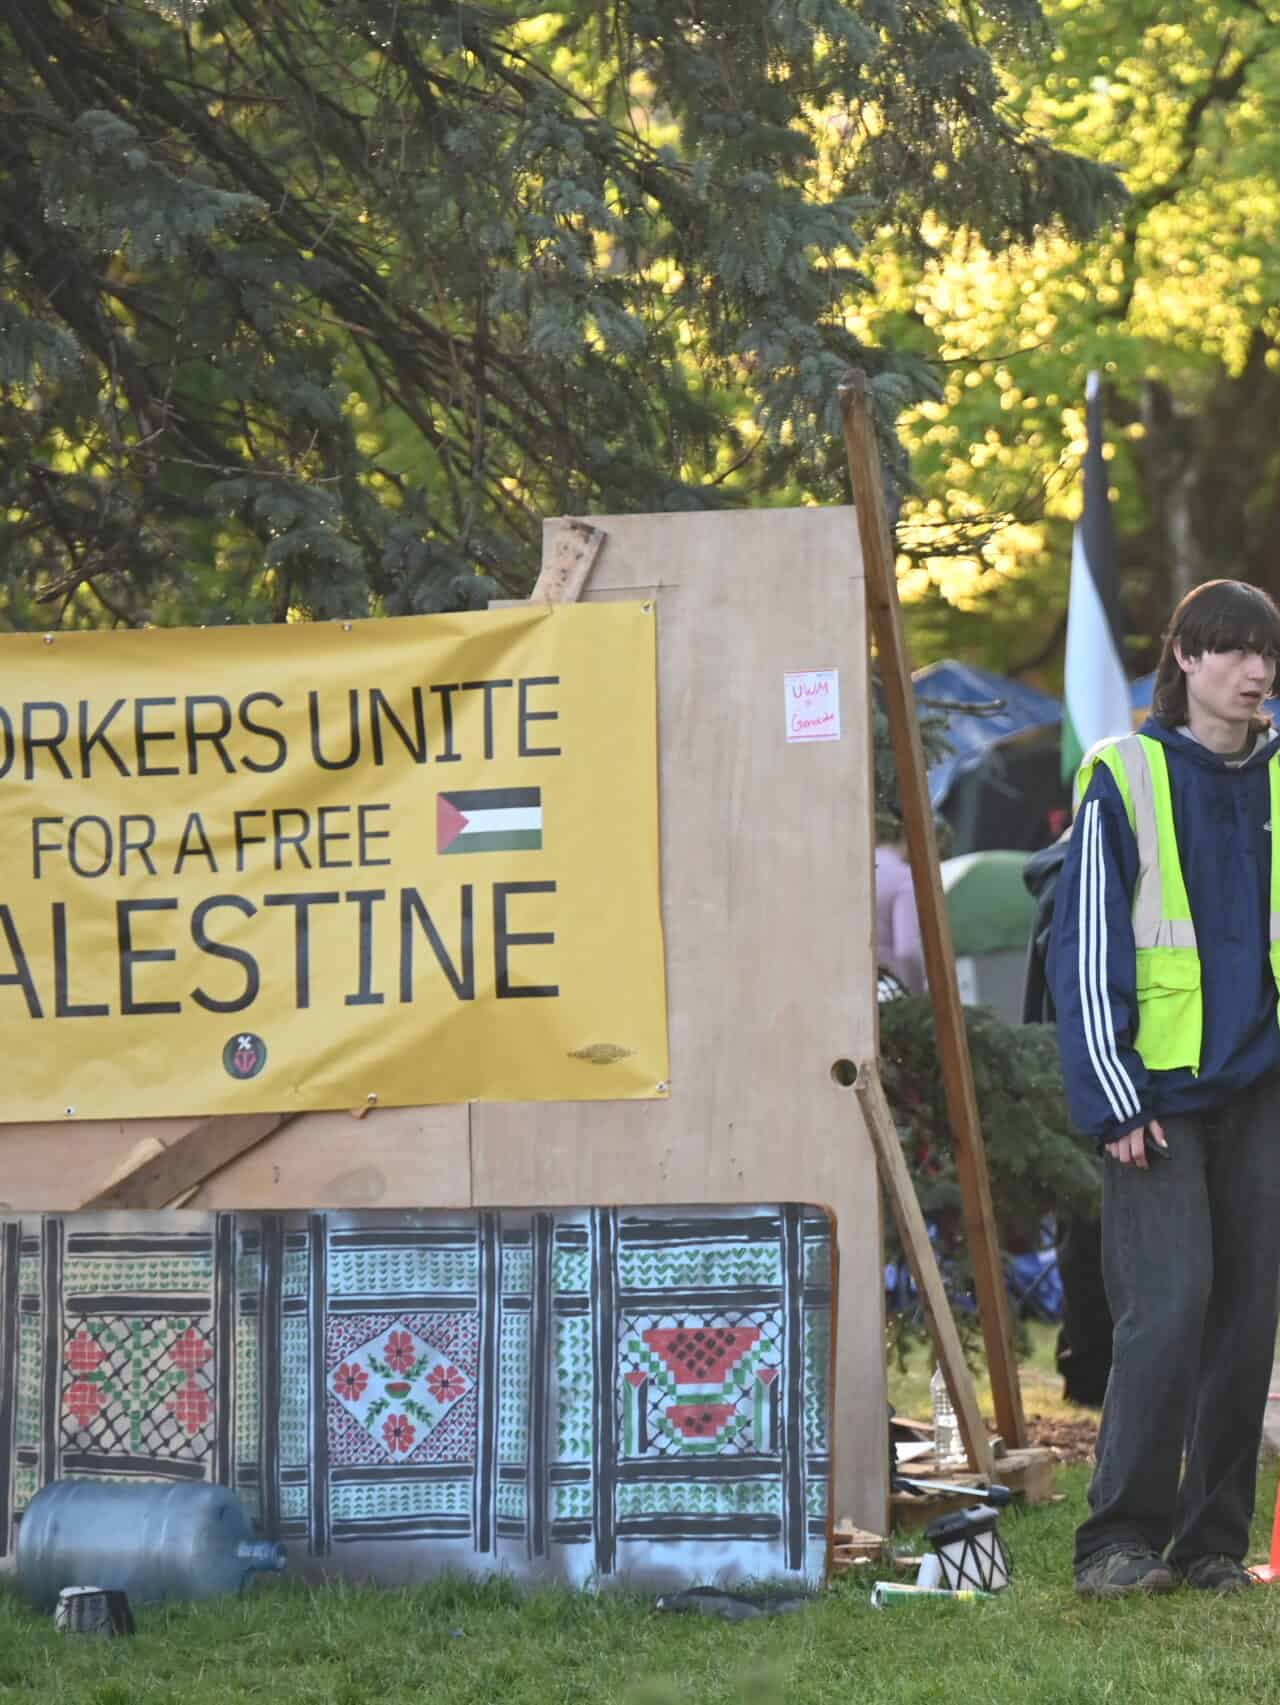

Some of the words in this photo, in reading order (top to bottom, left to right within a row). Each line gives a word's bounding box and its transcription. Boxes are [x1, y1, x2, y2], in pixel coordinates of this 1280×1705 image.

[0, 691, 288, 780] RKERS
[309, 676, 562, 770] UNITE
[32, 813, 158, 879] FOR
[174, 812, 218, 875] A
[235, 803, 392, 871] FREE
